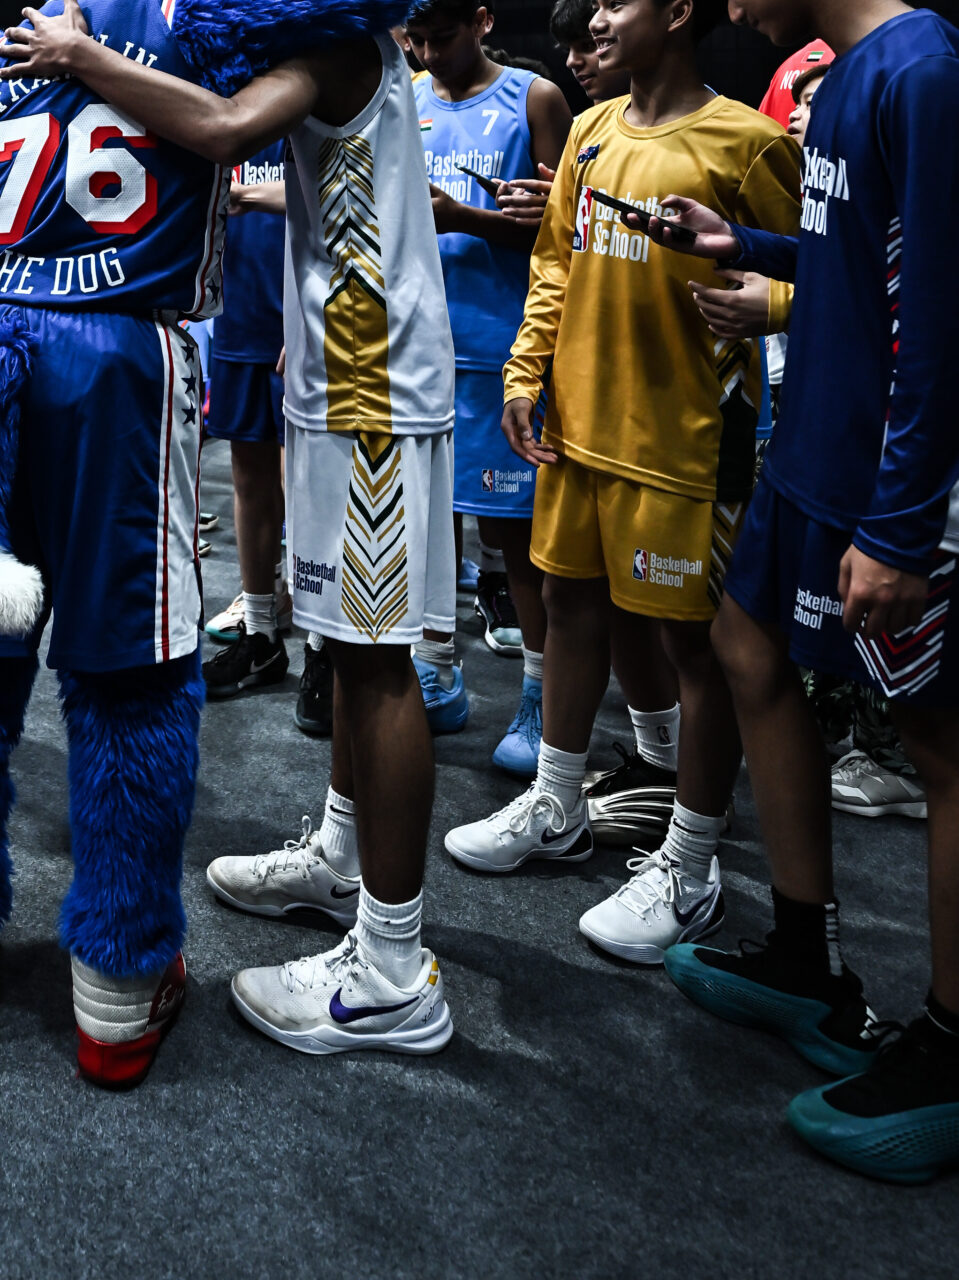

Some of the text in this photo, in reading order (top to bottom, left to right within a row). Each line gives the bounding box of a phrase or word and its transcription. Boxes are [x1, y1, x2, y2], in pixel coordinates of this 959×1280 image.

[780, 69, 805, 90] NO
[481, 109, 500, 136] 7
[424, 148, 504, 178] Basketball
[592, 221, 650, 263] School
[50, 246, 126, 295] DOG
[494, 470, 533, 482] Basketball
[494, 481, 520, 493] School
[296, 555, 337, 583] Basketball
[650, 552, 703, 576] Basketball
[295, 572, 324, 596] School
[649, 568, 684, 588] School
